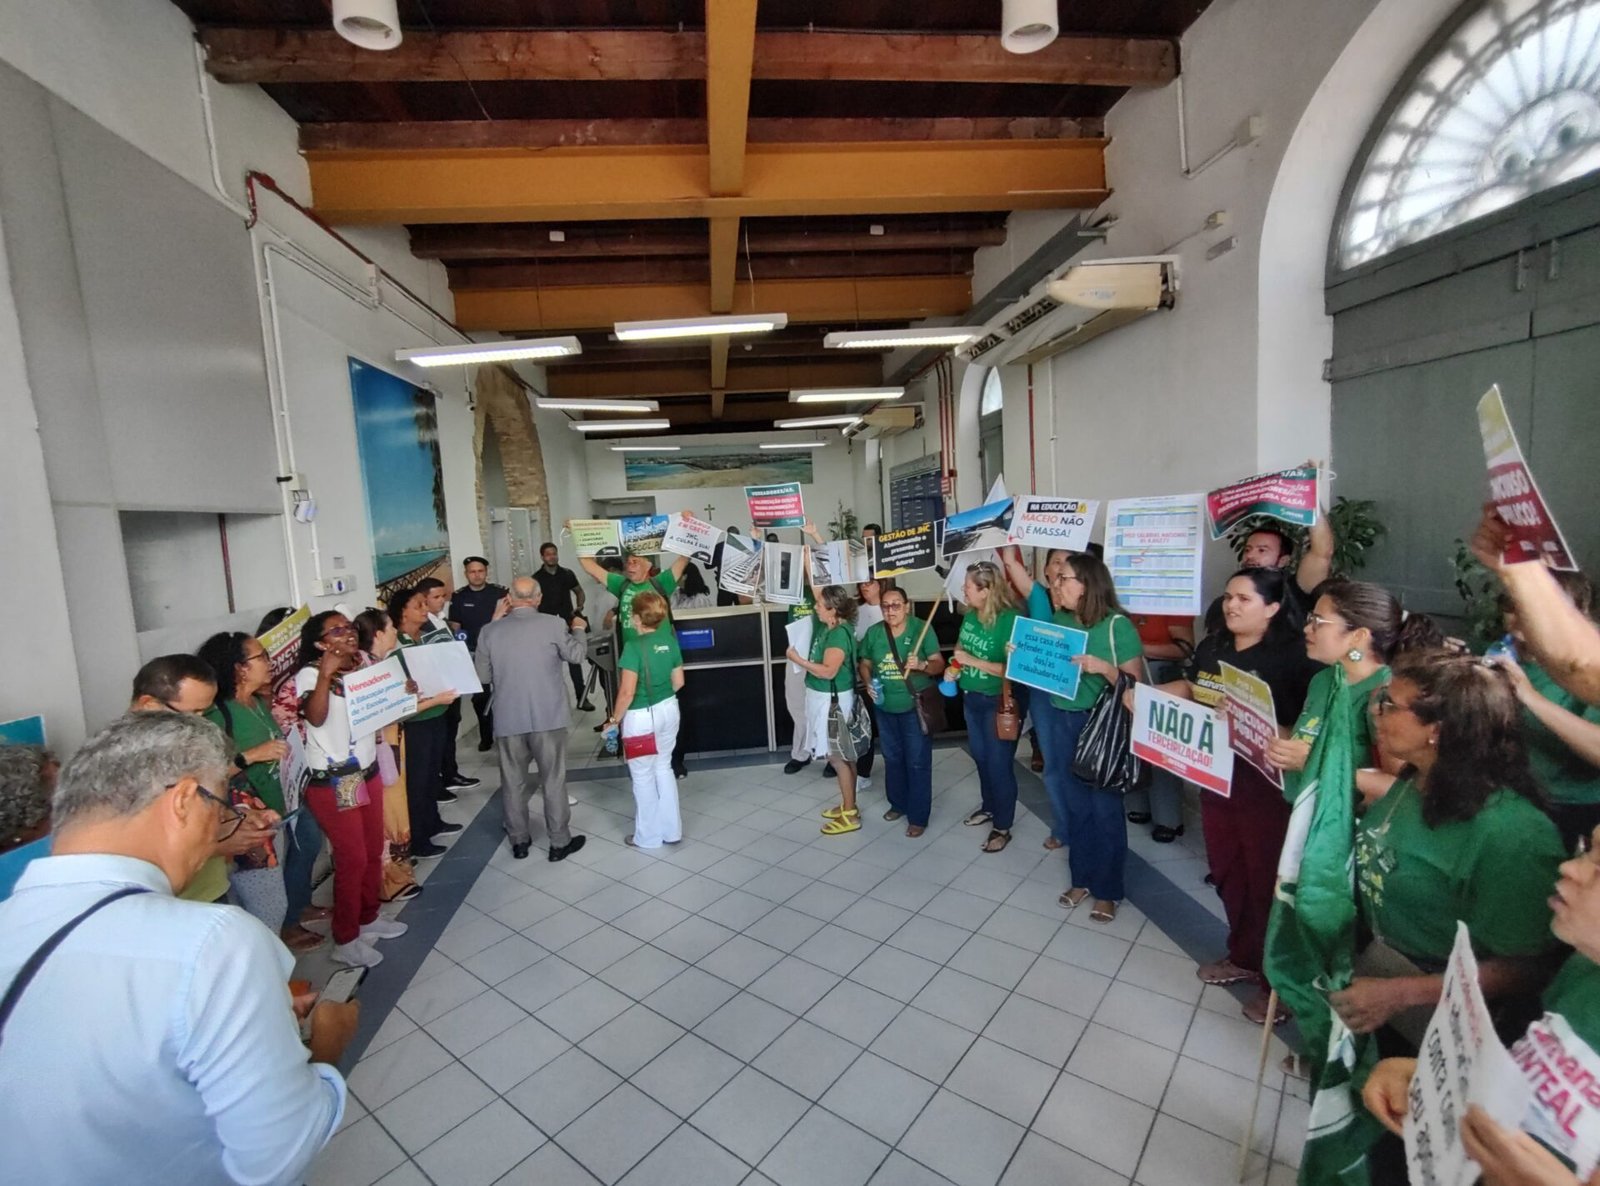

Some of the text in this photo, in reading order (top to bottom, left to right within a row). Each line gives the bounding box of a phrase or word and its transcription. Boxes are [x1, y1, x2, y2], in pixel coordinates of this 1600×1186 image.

[1041, 502, 1077, 512] EDUCAÇÃO
[1060, 515, 1084, 526] NÃO
[879, 530, 906, 542] GESTÃO
[1032, 526, 1072, 538] MASSA!
[347, 671, 392, 693] Vereadores
[1148, 700, 1214, 755] NÃO À
